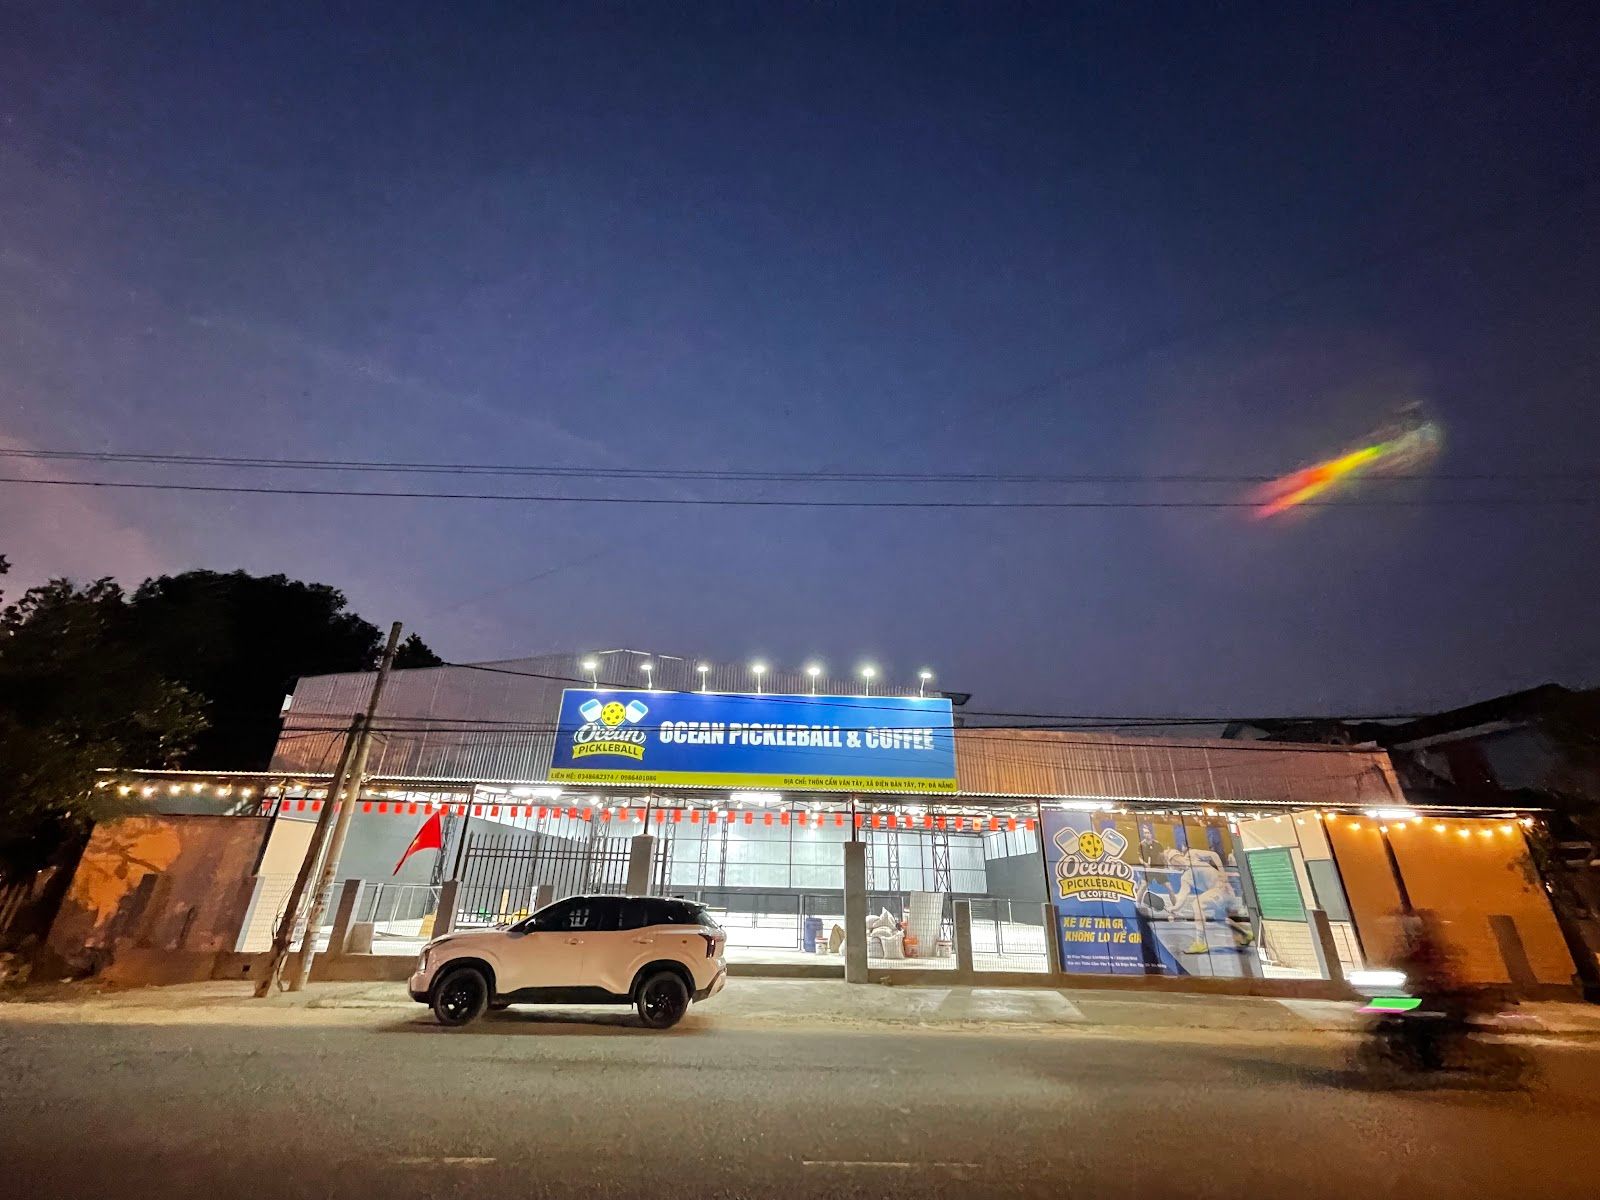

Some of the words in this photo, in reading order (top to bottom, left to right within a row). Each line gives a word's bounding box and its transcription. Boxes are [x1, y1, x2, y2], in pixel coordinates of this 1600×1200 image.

[577, 722, 646, 744] Ocean
[659, 720, 725, 745] OCEAN
[728, 722, 842, 747] PICKLEBALL
[846, 727, 861, 748] &
[865, 726, 934, 750] COFFEE
[578, 743, 639, 756] PICKLEBALL
[1062, 855, 1129, 877] Ocean
[1067, 878, 1128, 892] PICKLEBALL
[1080, 890, 1087, 898] &
[1087, 890, 1117, 900] COFFEE
